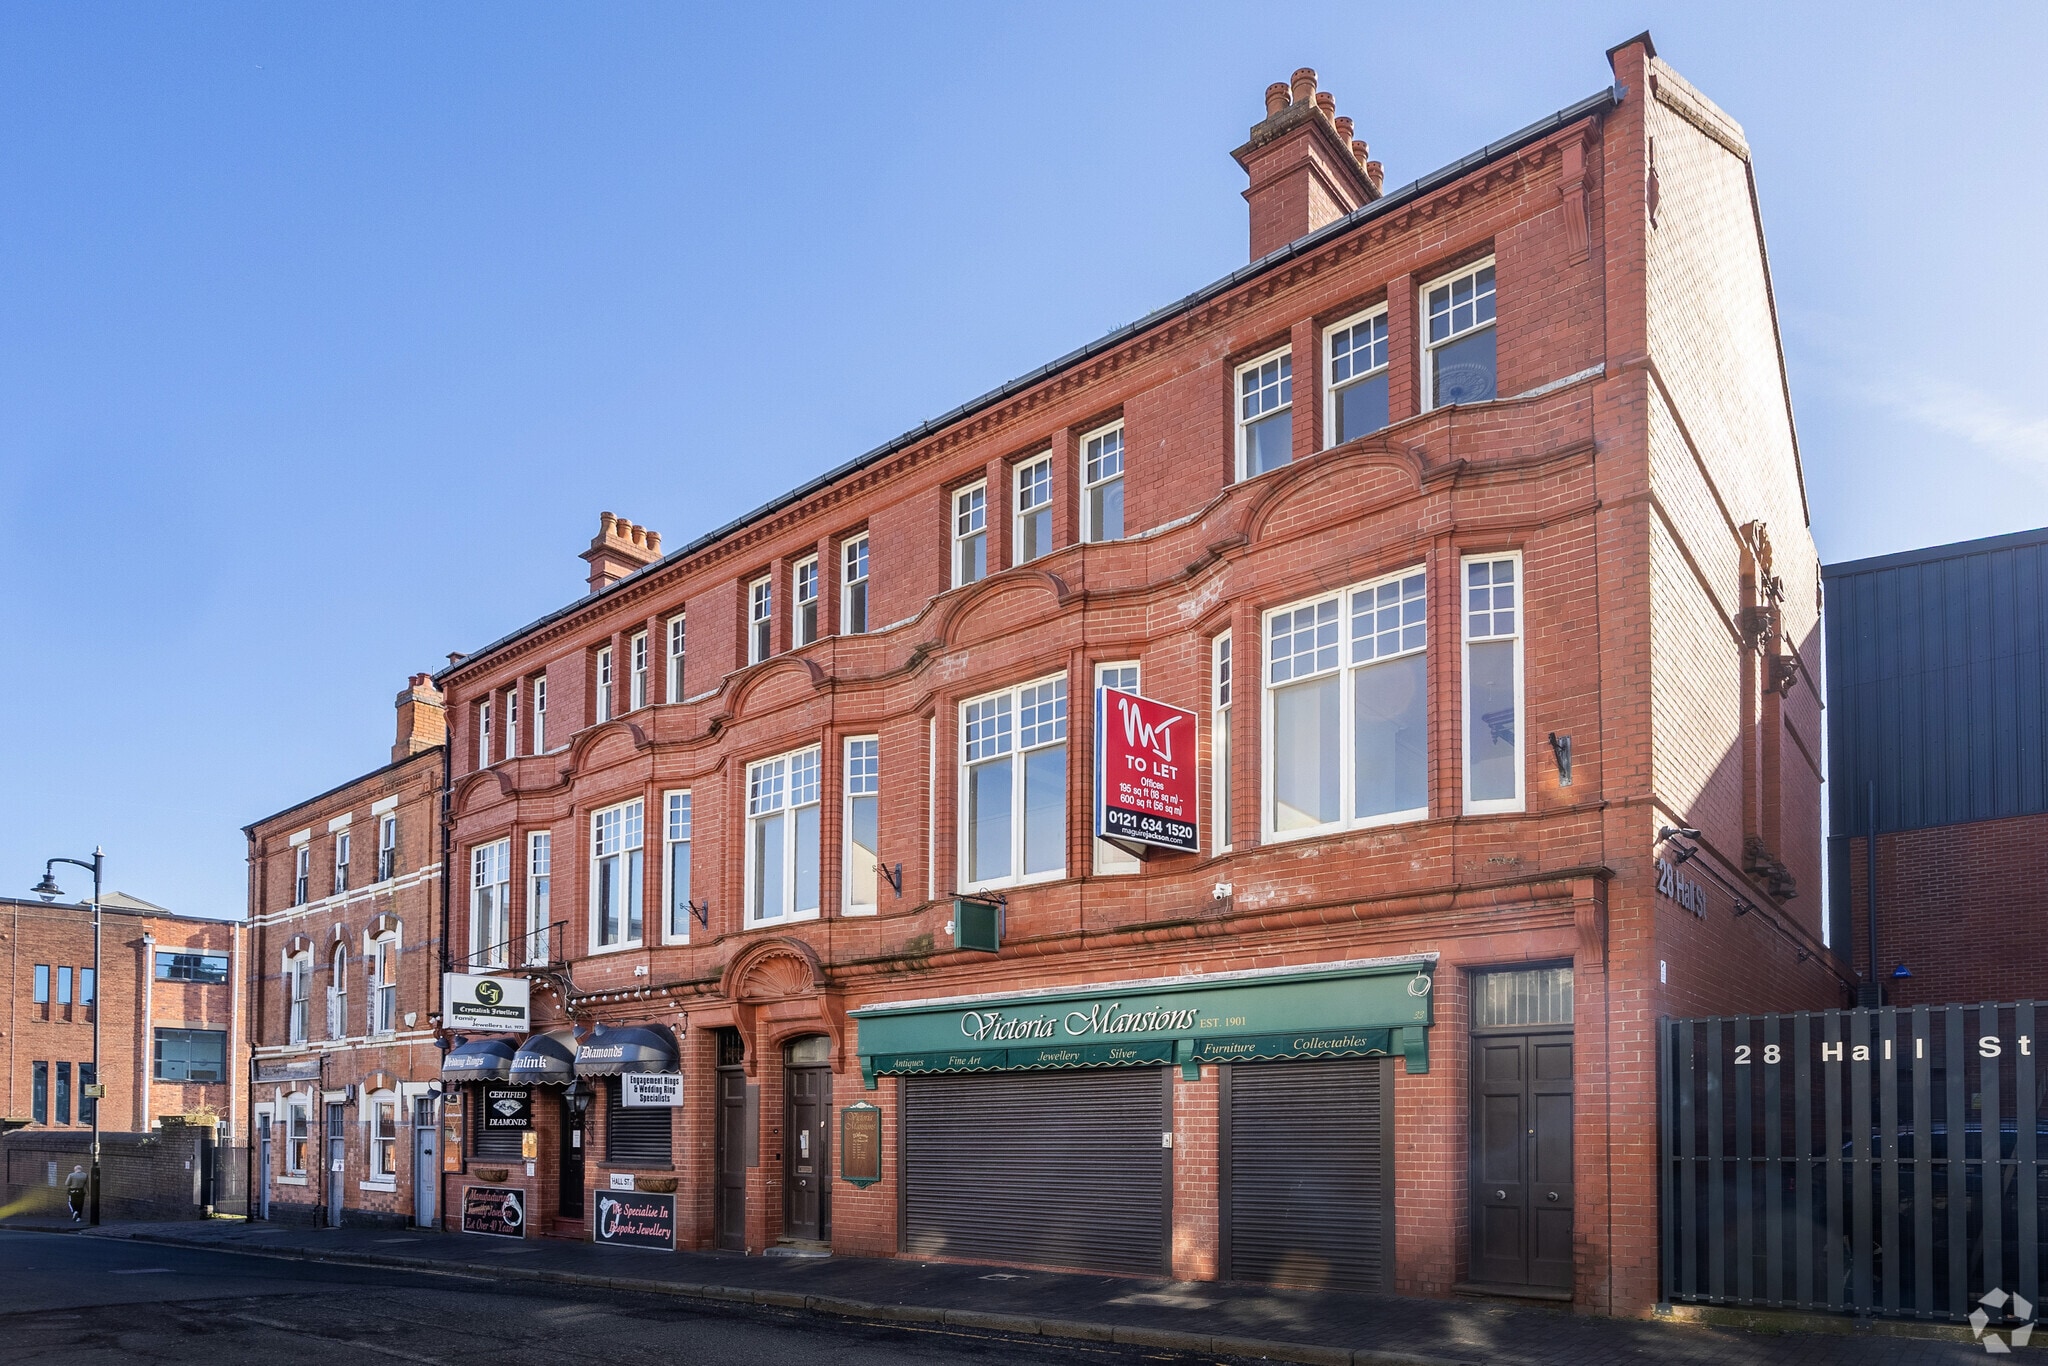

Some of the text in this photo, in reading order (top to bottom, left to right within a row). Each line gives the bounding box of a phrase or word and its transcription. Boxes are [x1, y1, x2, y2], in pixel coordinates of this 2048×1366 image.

[1125, 754, 1178, 780] TO LET
[1140, 776, 1164, 790] Offices
[1119, 782, 1132, 793] 195
[1133, 787, 1142, 798] sq
[1143, 788, 1149, 797] ft
[1150, 788, 1160, 799] (18
[1161, 793, 1169, 804] sq
[1170, 794, 1178, 805] m)
[1120, 793, 1183, 817] 600 sq ft (56 sq m)
[1108, 810, 1193, 839] 0121 634 1520
[1121, 827, 1183, 844] maguirejackson.com
[1659, 858, 1708, 920] 28 Hall St
[459, 1006, 519, 1016] Crystalink Jewellery
[472, 1021, 502, 1029] Jewellers
[960, 1003, 1246, 1041] Victoria Mansions EST. 1901
[1204, 1035, 1368, 1054] Furniture Collectables
[1734, 1034, 2032, 1065] 28 Hall St
[580, 1045, 624, 1060] Diamonds
[893, 1048, 1137, 1069] Antiques Fine Art Jewellery Silver
[630, 1075, 679, 1086] Engagement Rings
[489, 1090, 528, 1098] CERTIFIED
[633, 1085, 676, 1095] & Wedding Ring
[640, 1094, 671, 1103] Specialists
[489, 1118, 528, 1126] DIAMONDS
[611, 1177, 623, 1185] HALL
[612, 1203, 668, 1218] We Specialise In
[476, 1219, 488, 1230] Over
[609, 1220, 671, 1240] Bespoke Jewellery
